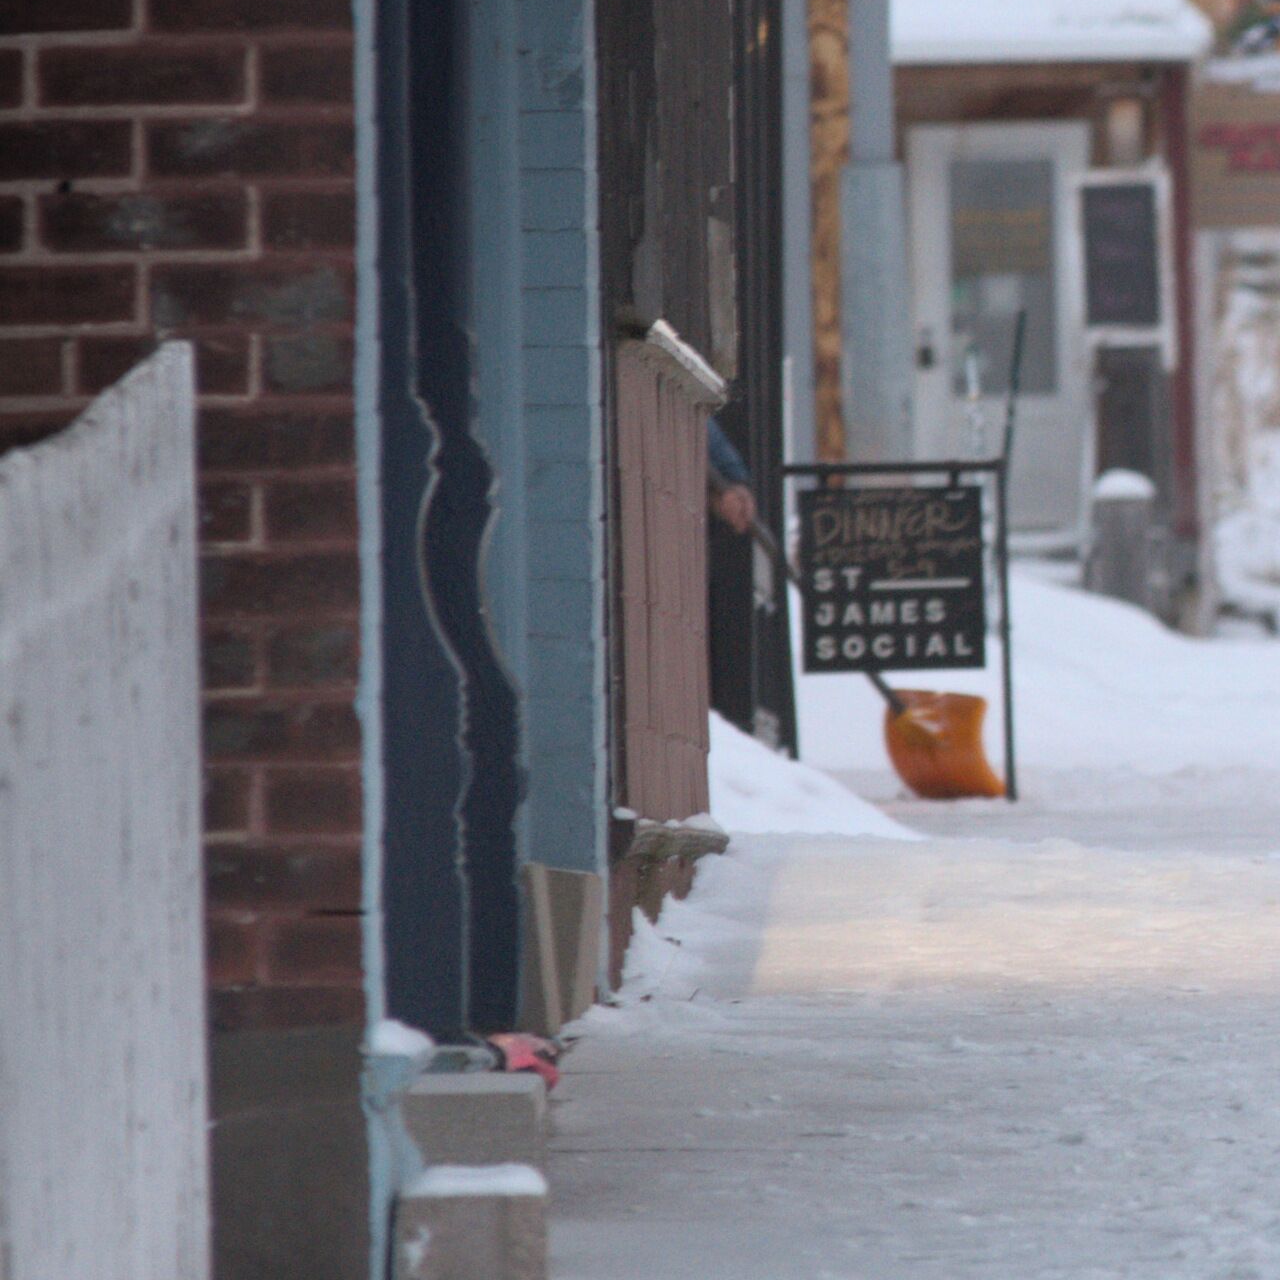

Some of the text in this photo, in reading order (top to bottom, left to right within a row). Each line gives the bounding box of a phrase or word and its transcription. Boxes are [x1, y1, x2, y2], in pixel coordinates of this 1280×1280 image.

[812, 568, 862, 592] ST
[815, 599, 946, 626] JAMES
[815, 634, 973, 660] SOCIAL
